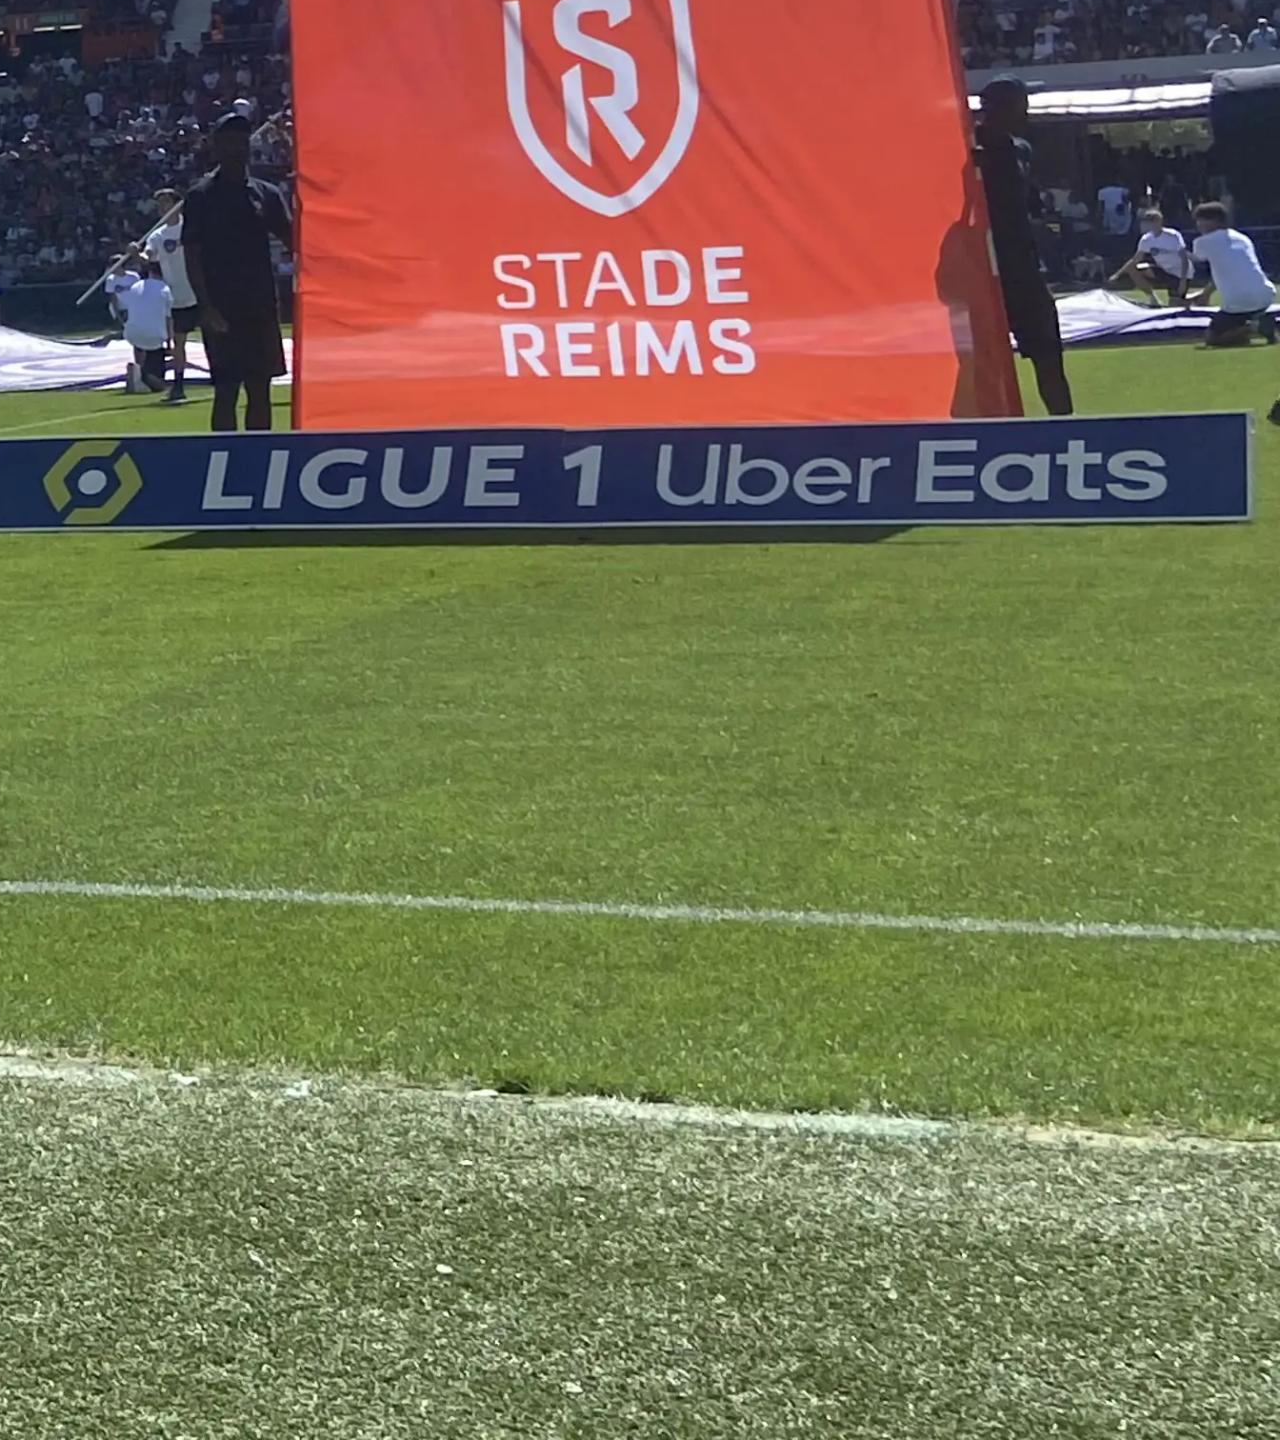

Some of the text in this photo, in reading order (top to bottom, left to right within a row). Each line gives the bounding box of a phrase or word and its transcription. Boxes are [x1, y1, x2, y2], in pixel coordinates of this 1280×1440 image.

[492, 246, 749, 310] STADE
[499, 317, 757, 378] REIMS
[201, 438, 1169, 511] LIGUE 1 Uber Eats
